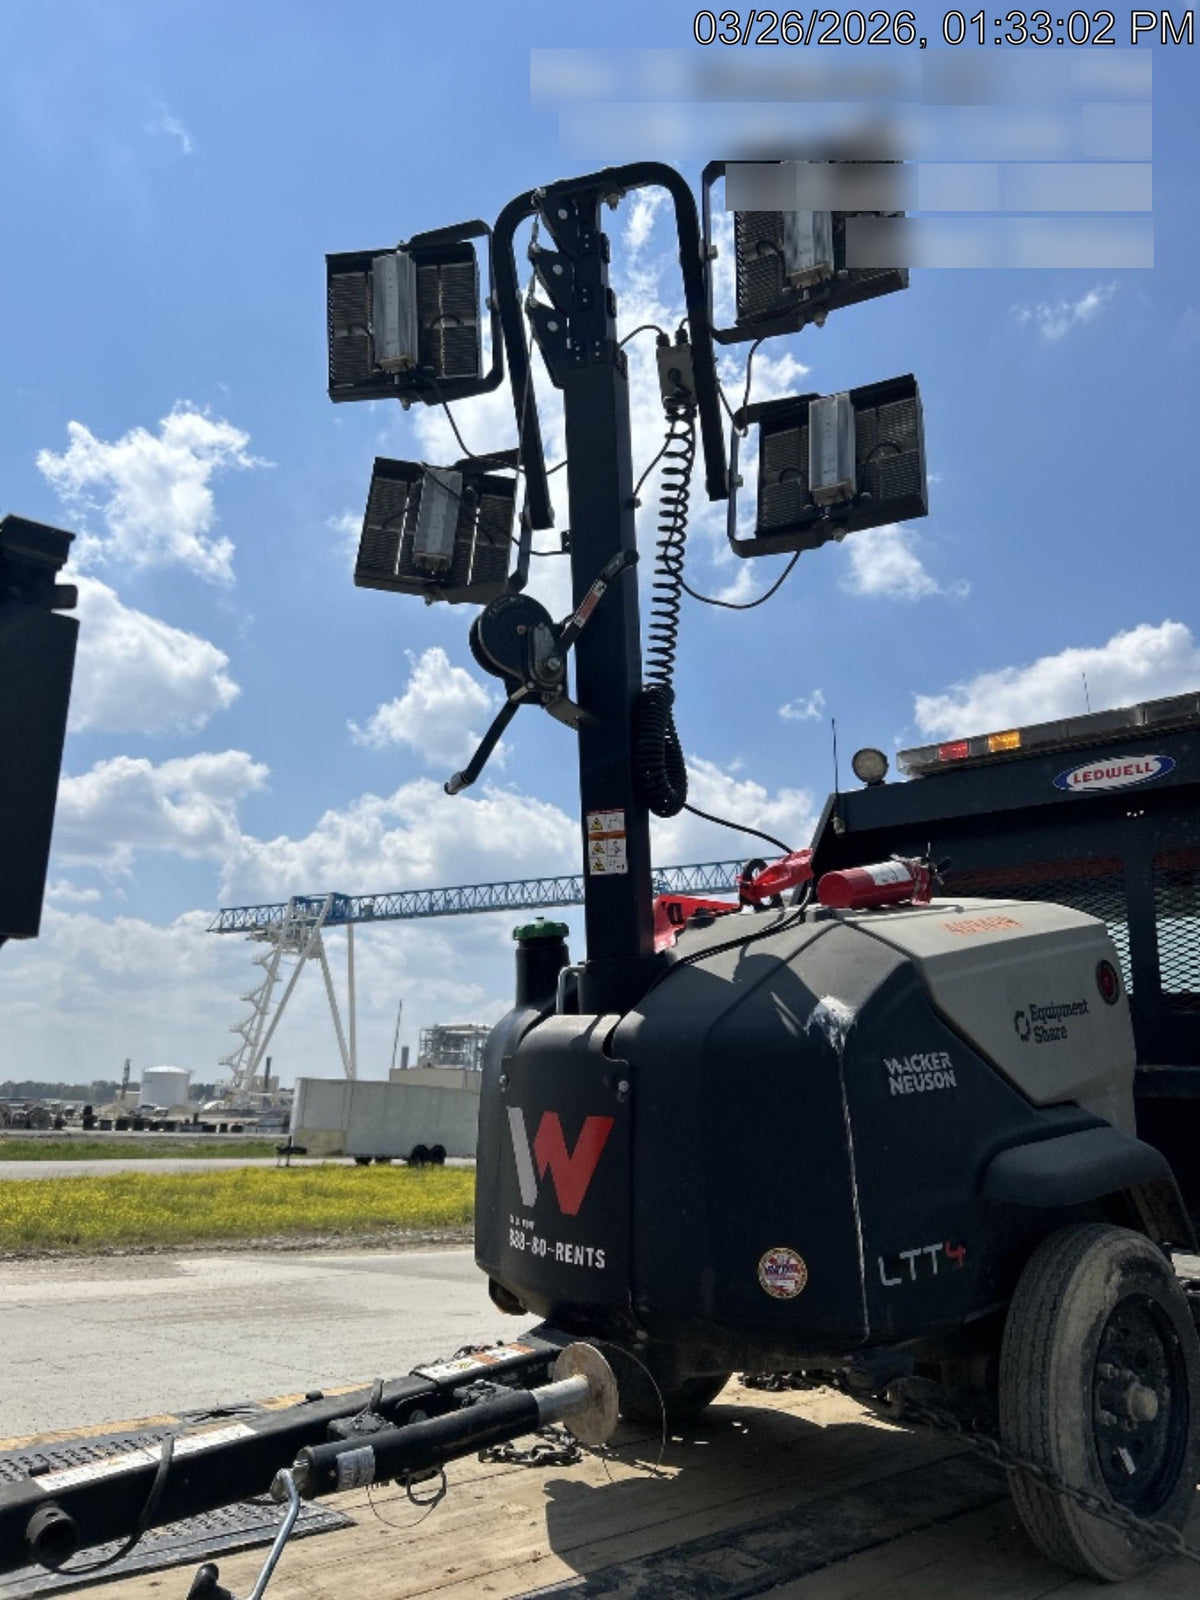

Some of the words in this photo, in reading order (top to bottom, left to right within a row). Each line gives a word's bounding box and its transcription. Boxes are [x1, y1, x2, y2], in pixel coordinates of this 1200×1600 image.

[1073, 762, 1154, 784] LEDWELL
[1029, 999, 1089, 1024] Equipment
[1033, 1025, 1068, 1044] Share
[883, 1051, 953, 1075] WACKER
[888, 1069, 957, 1096] NEUSON
